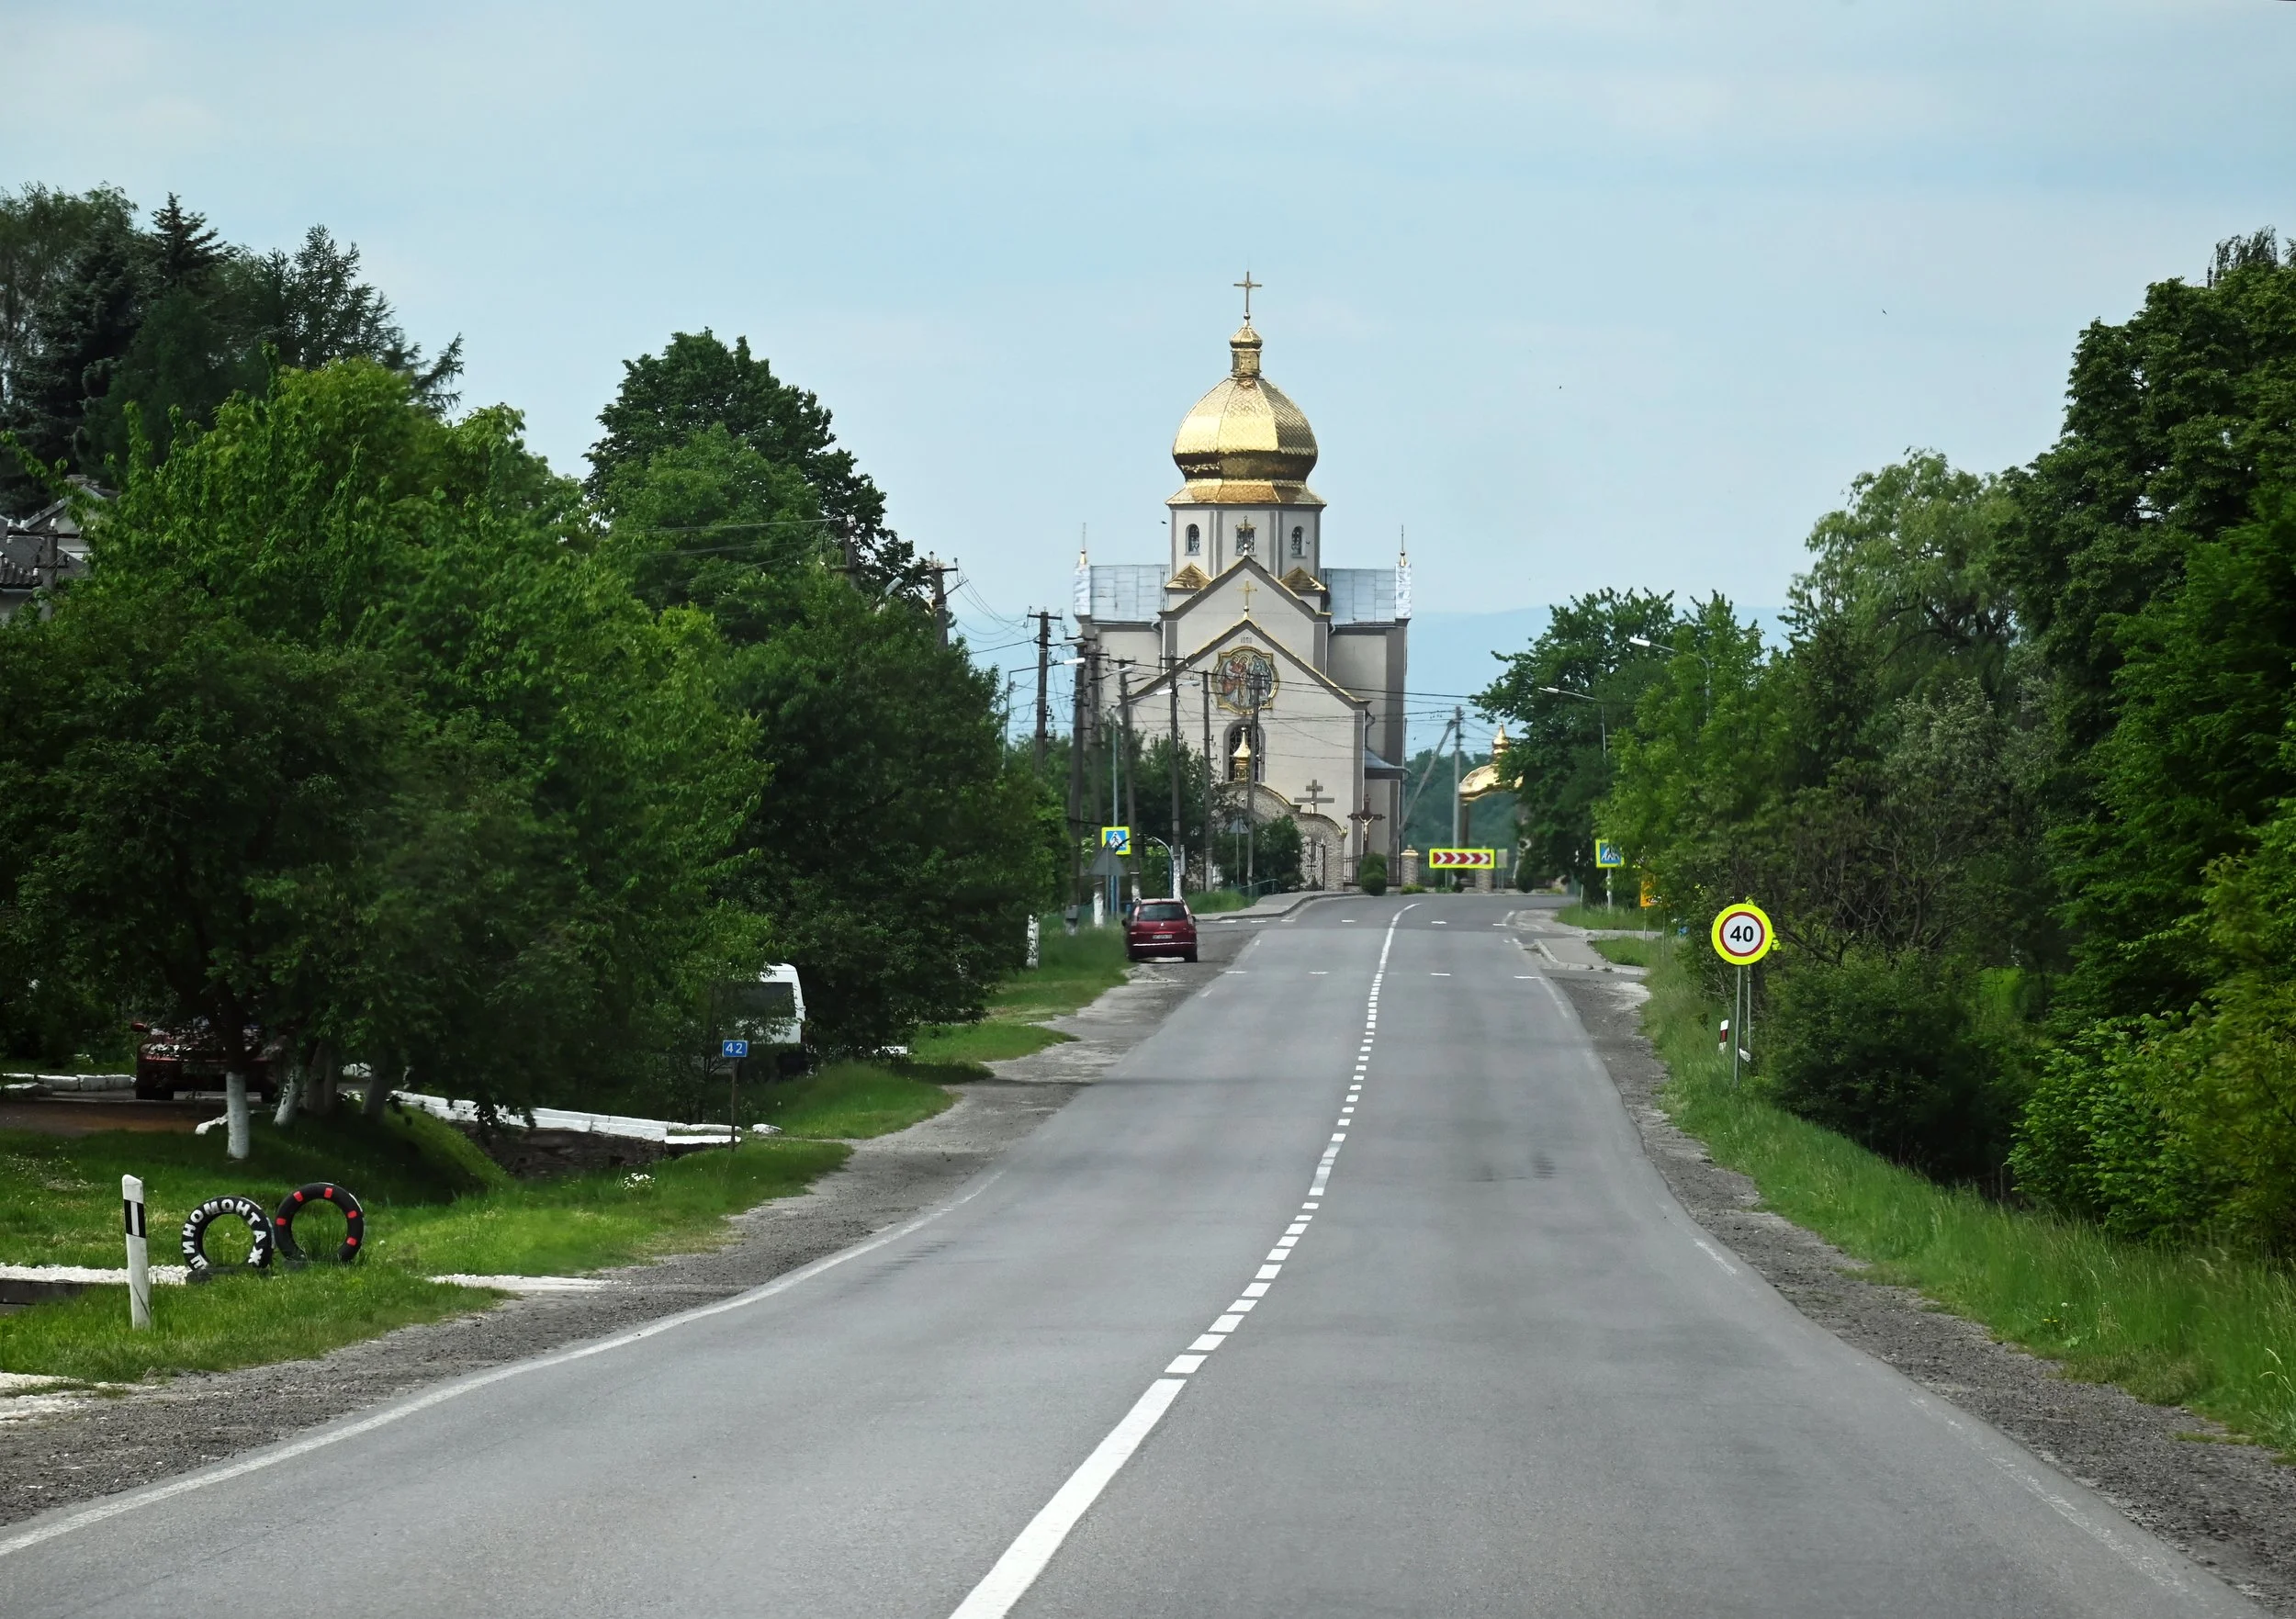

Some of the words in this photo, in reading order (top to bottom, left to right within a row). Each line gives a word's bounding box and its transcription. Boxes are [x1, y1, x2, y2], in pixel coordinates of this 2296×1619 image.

[1729, 925, 1754, 942] 40
[726, 1042, 743, 1053] 42
[182, 1198, 266, 1269] ШИНОМОНТАЖ
